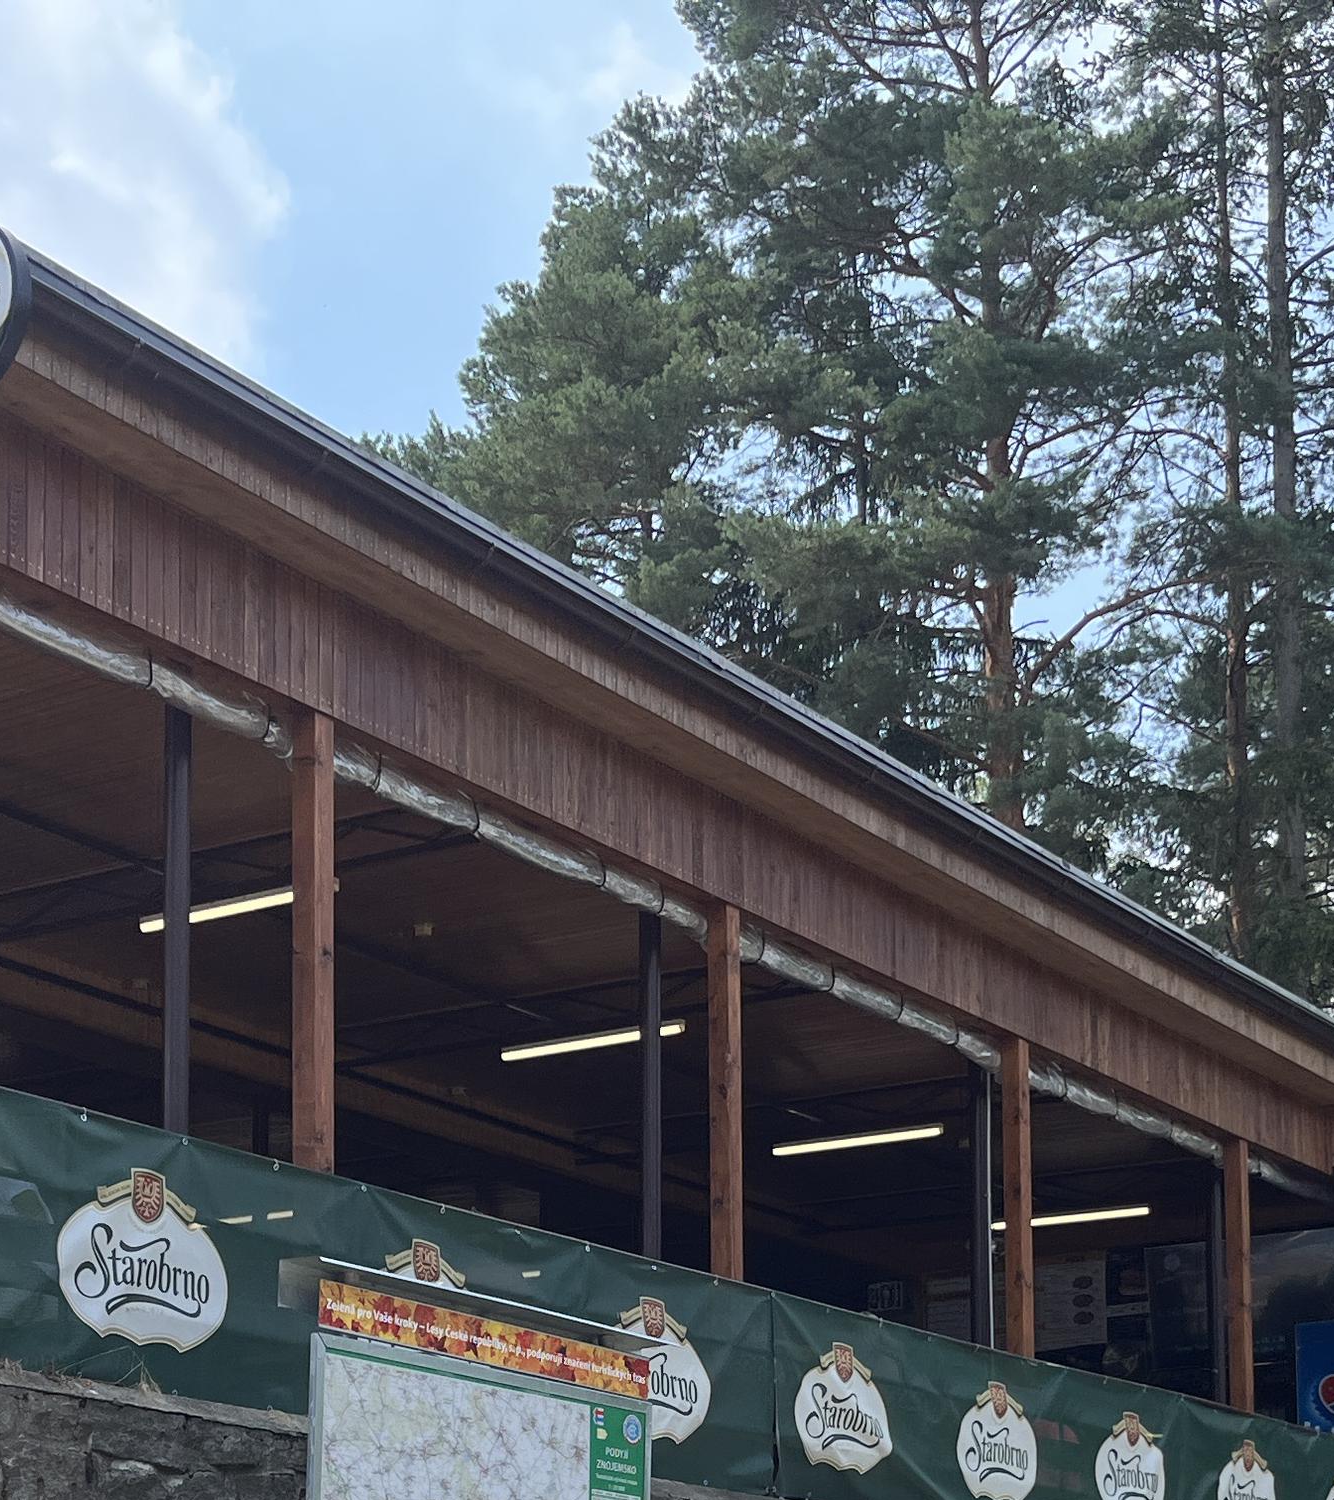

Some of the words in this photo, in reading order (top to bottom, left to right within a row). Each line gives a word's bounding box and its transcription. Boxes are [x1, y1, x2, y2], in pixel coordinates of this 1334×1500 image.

[74, 1222, 210, 1318] Starobrno
[326, 1298, 356, 1315] Zelená
[357, 1306, 373, 1320] pro
[373, 1309, 394, 1324] Vaše
[394, 1314, 419, 1332] kroky
[426, 1322, 444, 1340] Lesy
[445, 1324, 468, 1341] České
[469, 1335, 508, 1354] republiky,
[526, 1348, 563, 1368] podporují
[563, 1357, 592, 1371] značení
[592, 1362, 632, 1381] turistických
[632, 1371, 646, 1385] tras
[649, 1352, 698, 1416] obrno
[805, 1382, 884, 1450] Starobrno
[596, 1459, 637, 1475] ZNOJEMSKO
[965, 1420, 1028, 1483] Starobrno
